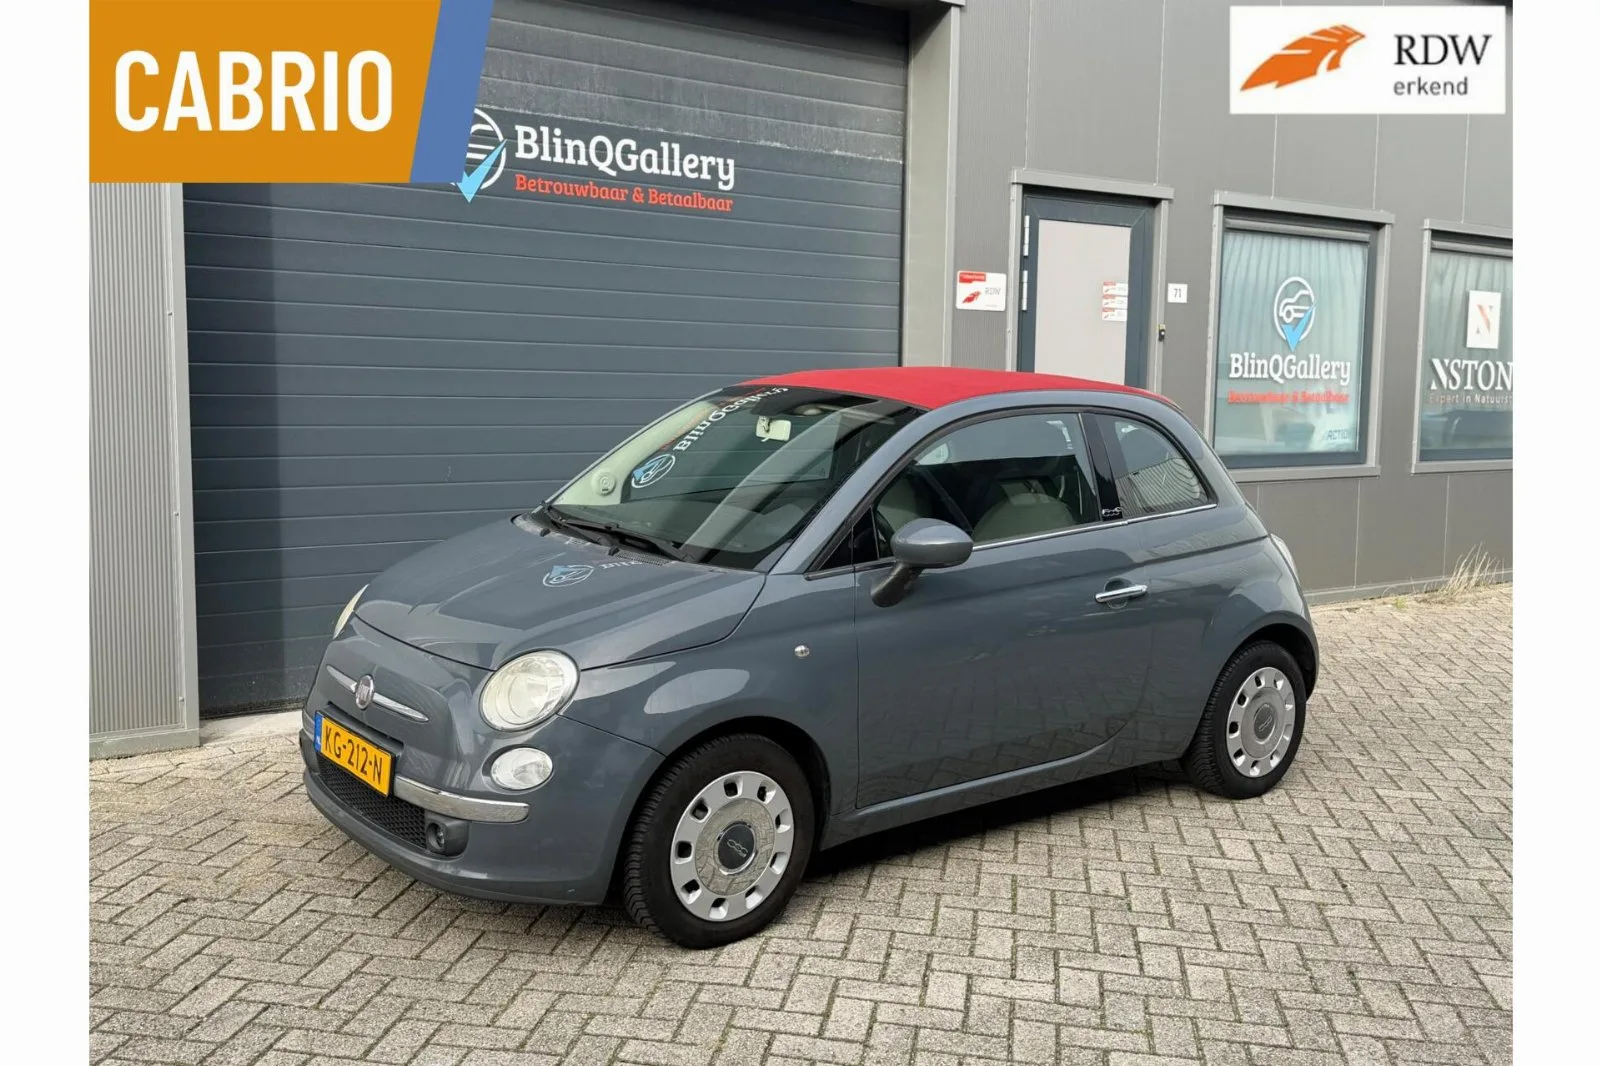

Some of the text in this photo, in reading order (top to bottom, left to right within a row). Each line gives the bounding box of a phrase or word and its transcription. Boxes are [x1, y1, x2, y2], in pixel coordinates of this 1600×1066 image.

[514, 124, 735, 191] BlinQGallery
[514, 173, 734, 212] Betrouwbaar & Betaalbaar
[1173, 288, 1182, 298] 71
[1228, 351, 1351, 386] BlinQGallery
[325, 725, 383, 785] KG-212-N
